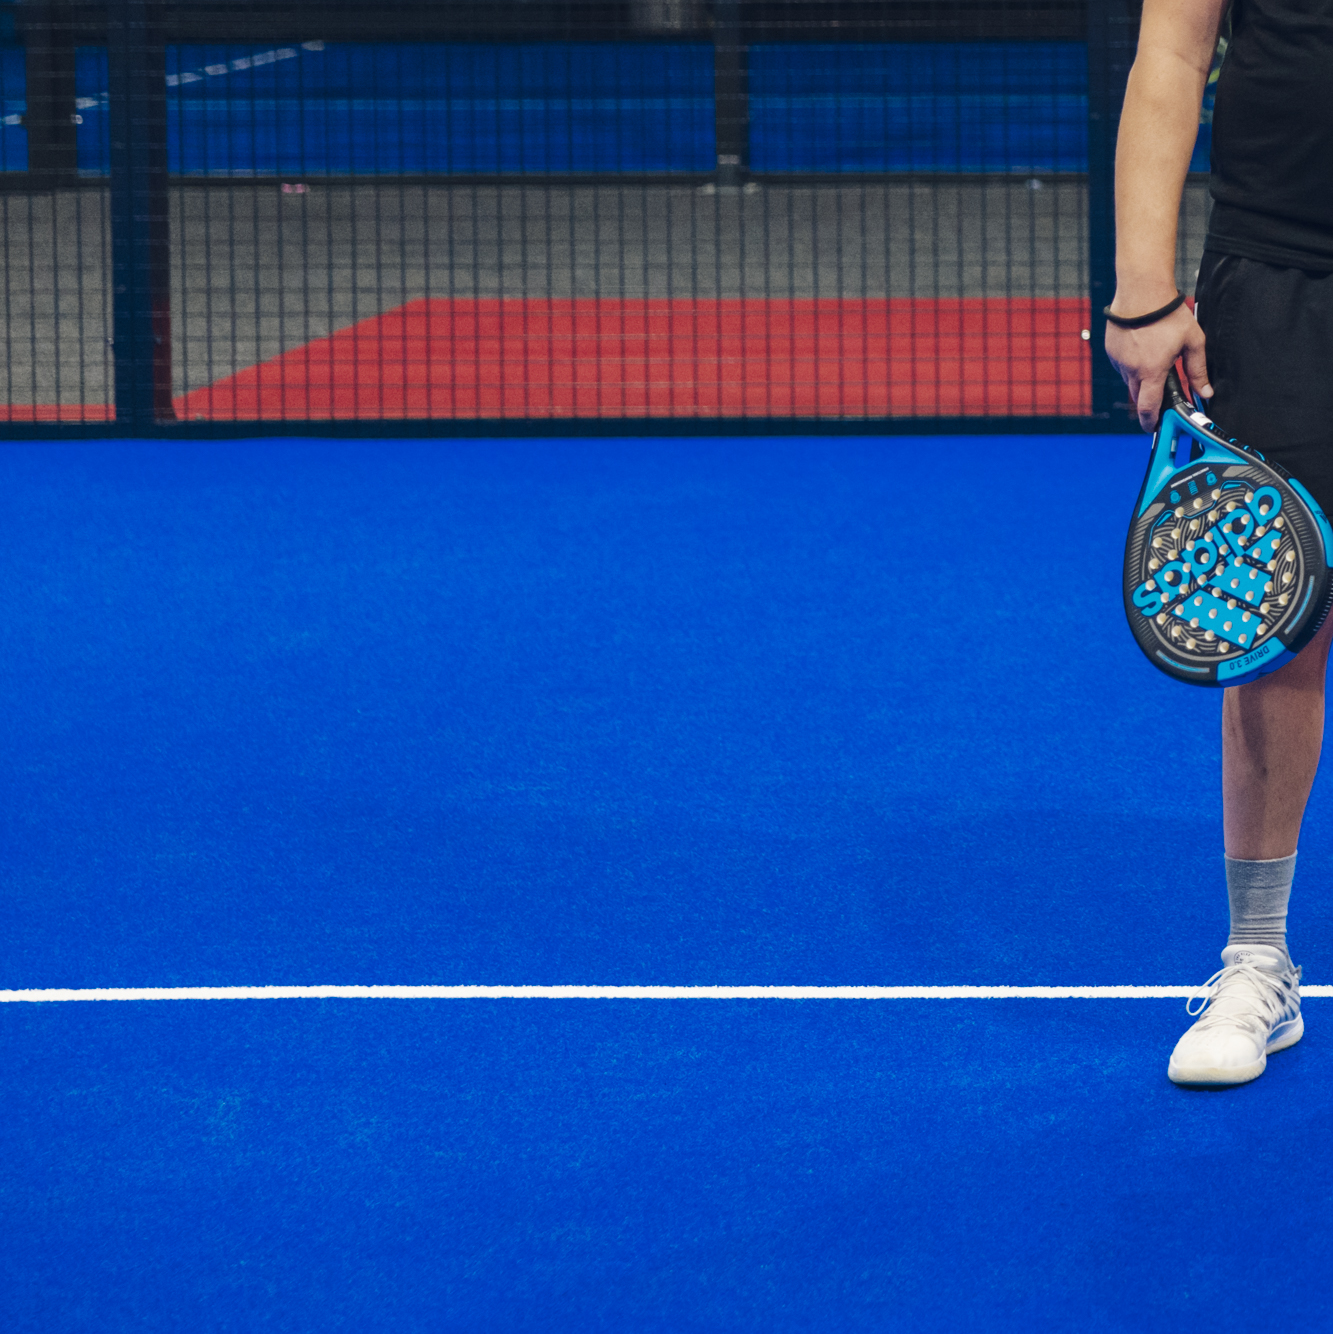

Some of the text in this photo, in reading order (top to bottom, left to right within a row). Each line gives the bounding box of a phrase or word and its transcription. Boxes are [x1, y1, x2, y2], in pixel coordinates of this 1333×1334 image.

[1132, 485, 1282, 617] adidas
[1229, 645, 1270, 671] DRIVE 3.0
